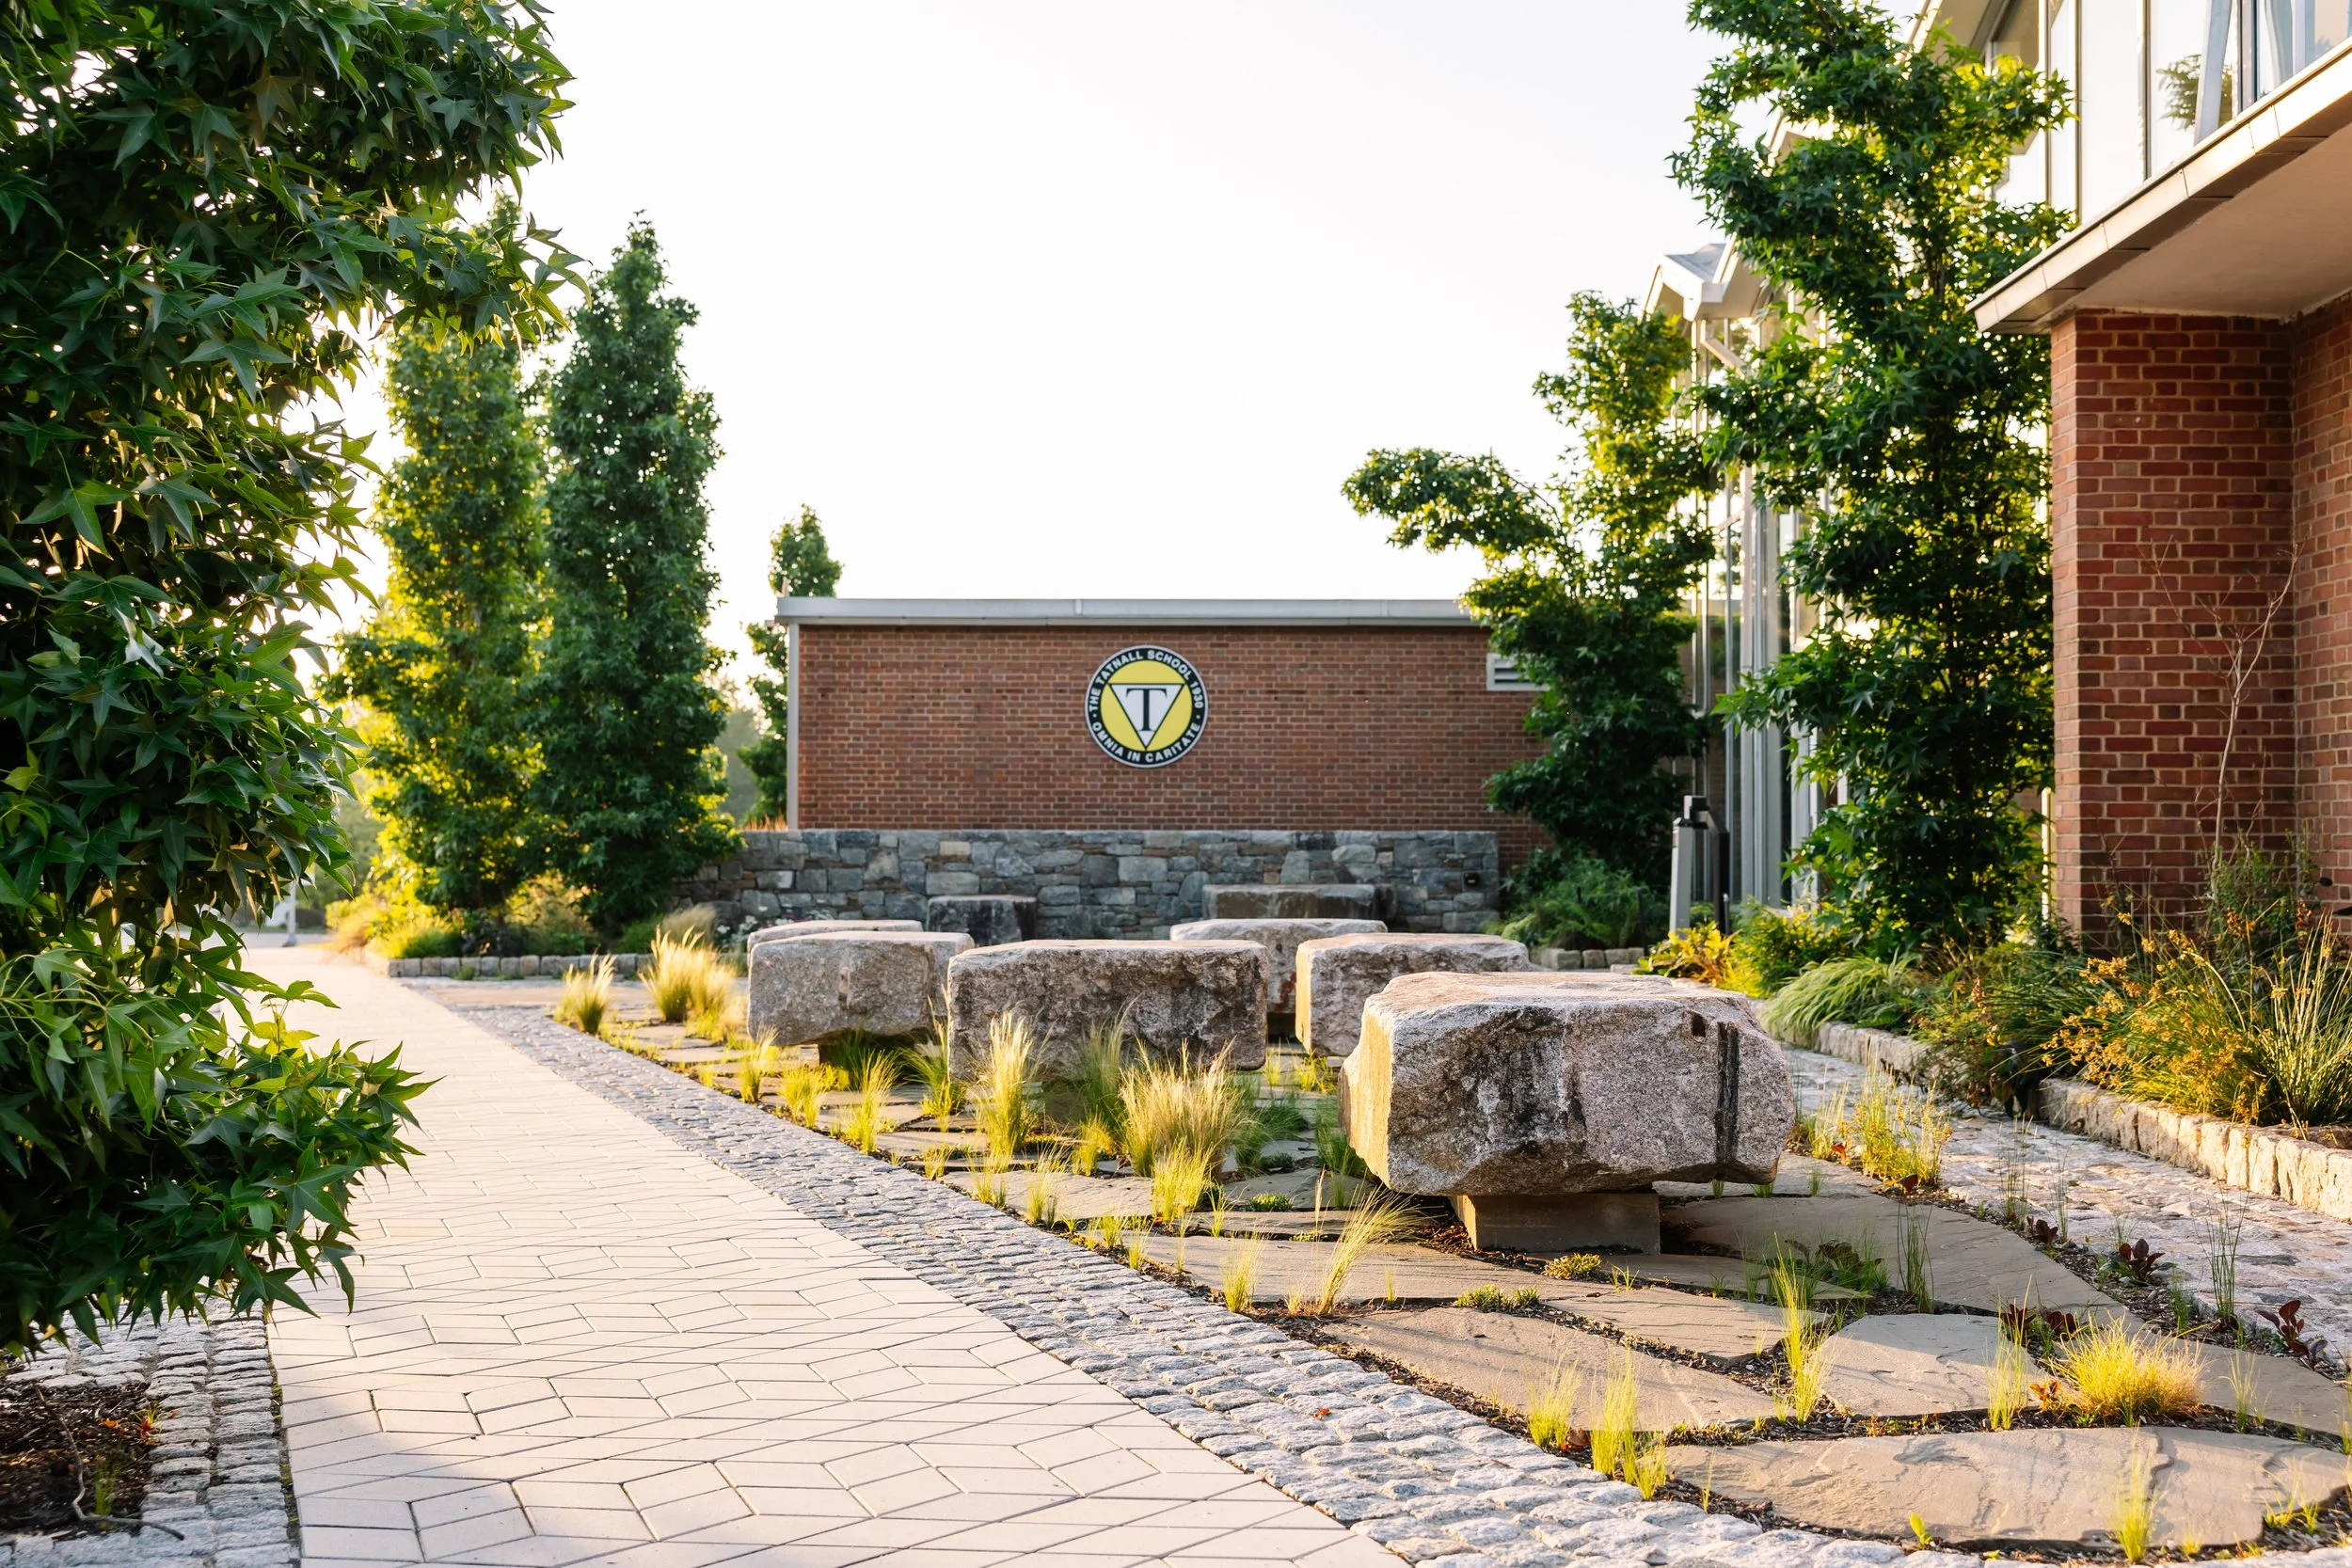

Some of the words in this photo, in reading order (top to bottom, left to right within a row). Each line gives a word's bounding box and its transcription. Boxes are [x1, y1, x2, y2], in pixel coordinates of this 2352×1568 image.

[1089, 688, 1101, 712] THE
[1095, 650, 1143, 685] TATNALL
[1147, 650, 1191, 680] SCHOOL
[1190, 681, 1203, 708] 1930
[1126, 688, 1168, 731] T
[1092, 721, 1124, 757] OMNIA
[1127, 751, 1140, 763] IN
[1145, 722, 1200, 763] CARITATE
